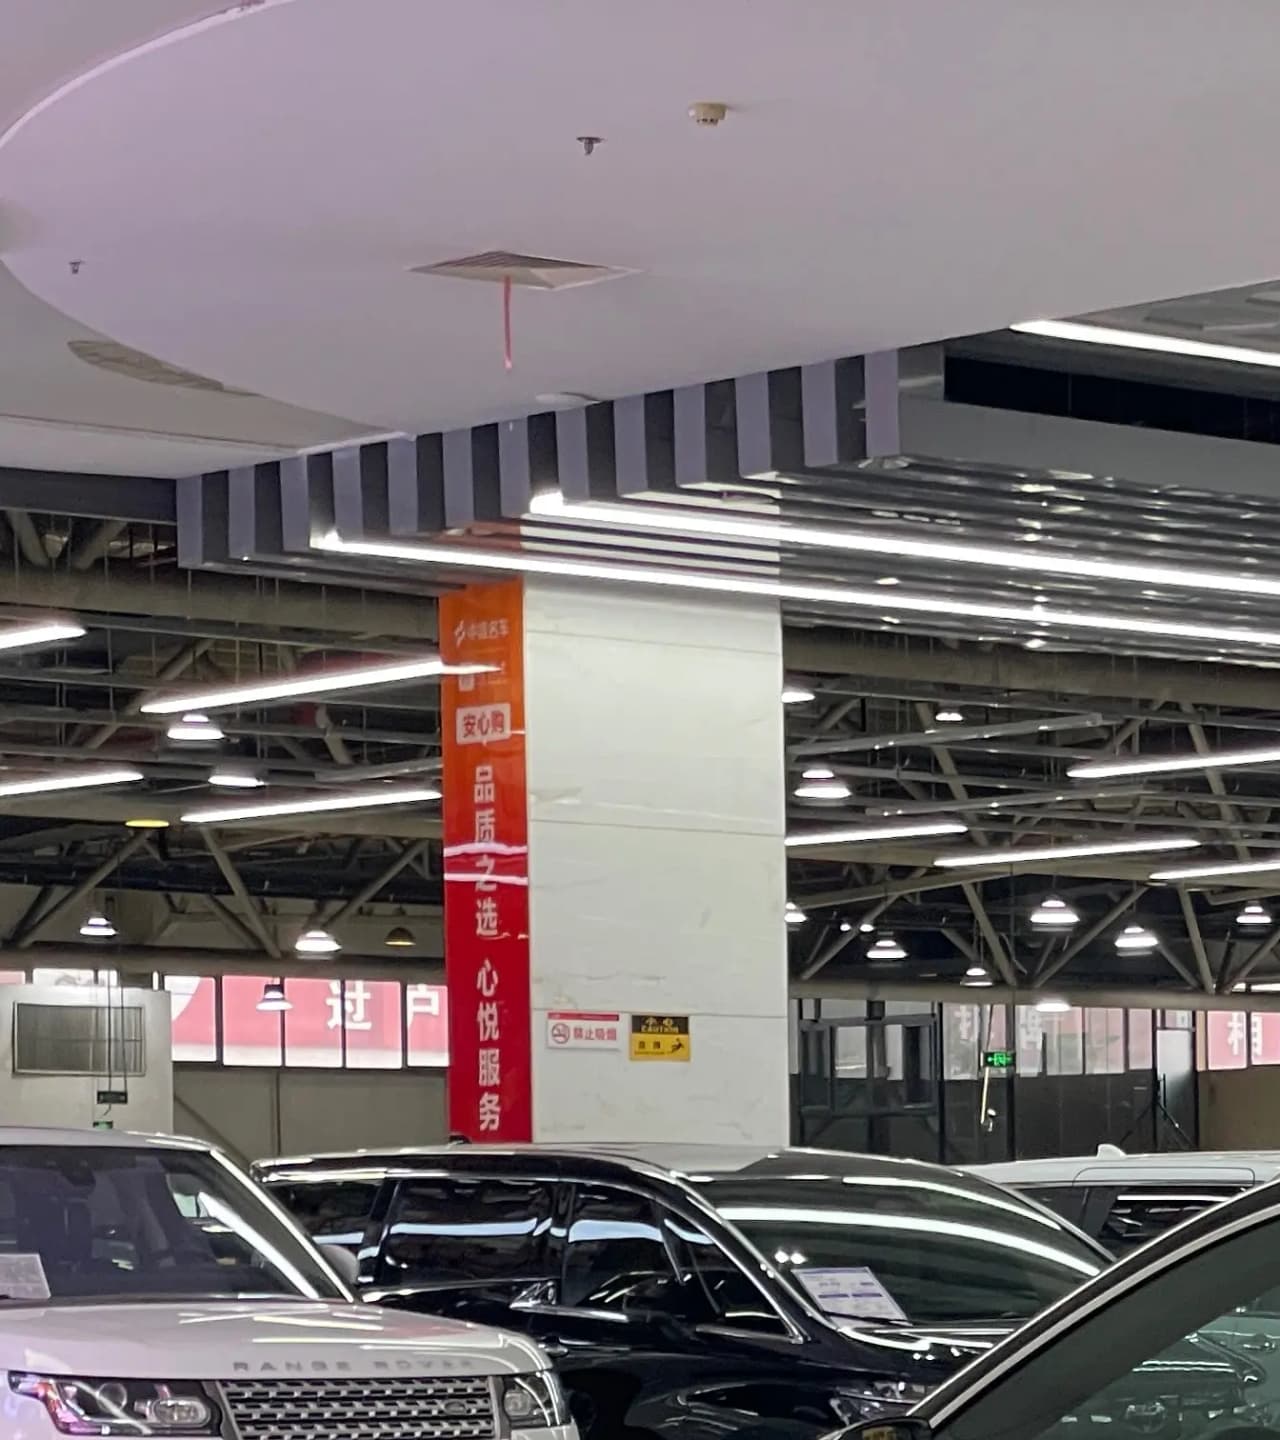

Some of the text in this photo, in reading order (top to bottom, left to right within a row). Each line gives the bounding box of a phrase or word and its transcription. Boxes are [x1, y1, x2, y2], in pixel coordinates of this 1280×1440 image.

[463, 711, 504, 738] 安心购
[476, 959, 501, 1131] 心悦服务
